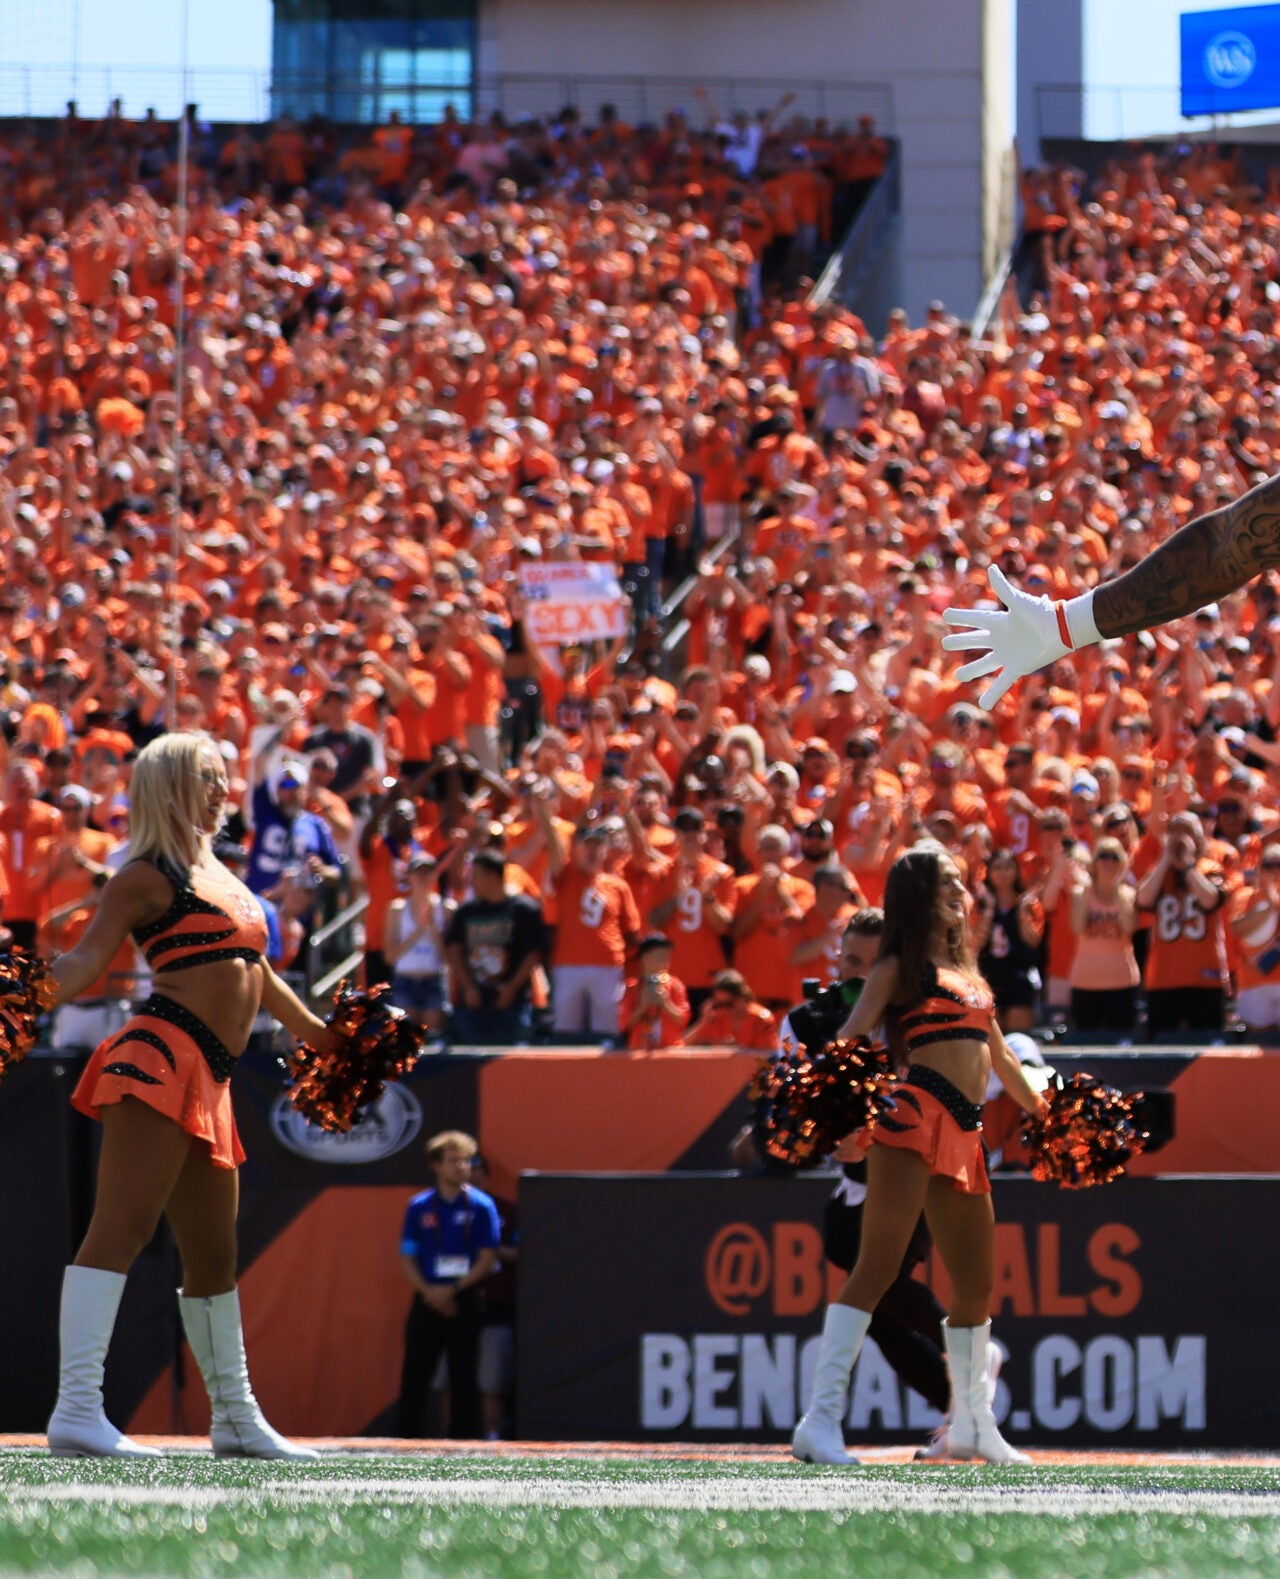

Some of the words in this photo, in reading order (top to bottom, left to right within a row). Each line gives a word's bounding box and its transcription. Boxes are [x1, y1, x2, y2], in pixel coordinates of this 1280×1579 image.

[534, 602, 618, 635] SEXY
[581, 885, 606, 929] 9
[680, 886, 703, 933] 9
[1158, 894, 1207, 942] 85
[706, 1222, 1143, 1317] @BALS
[641, 1333, 1207, 1431] BENAL.COM
